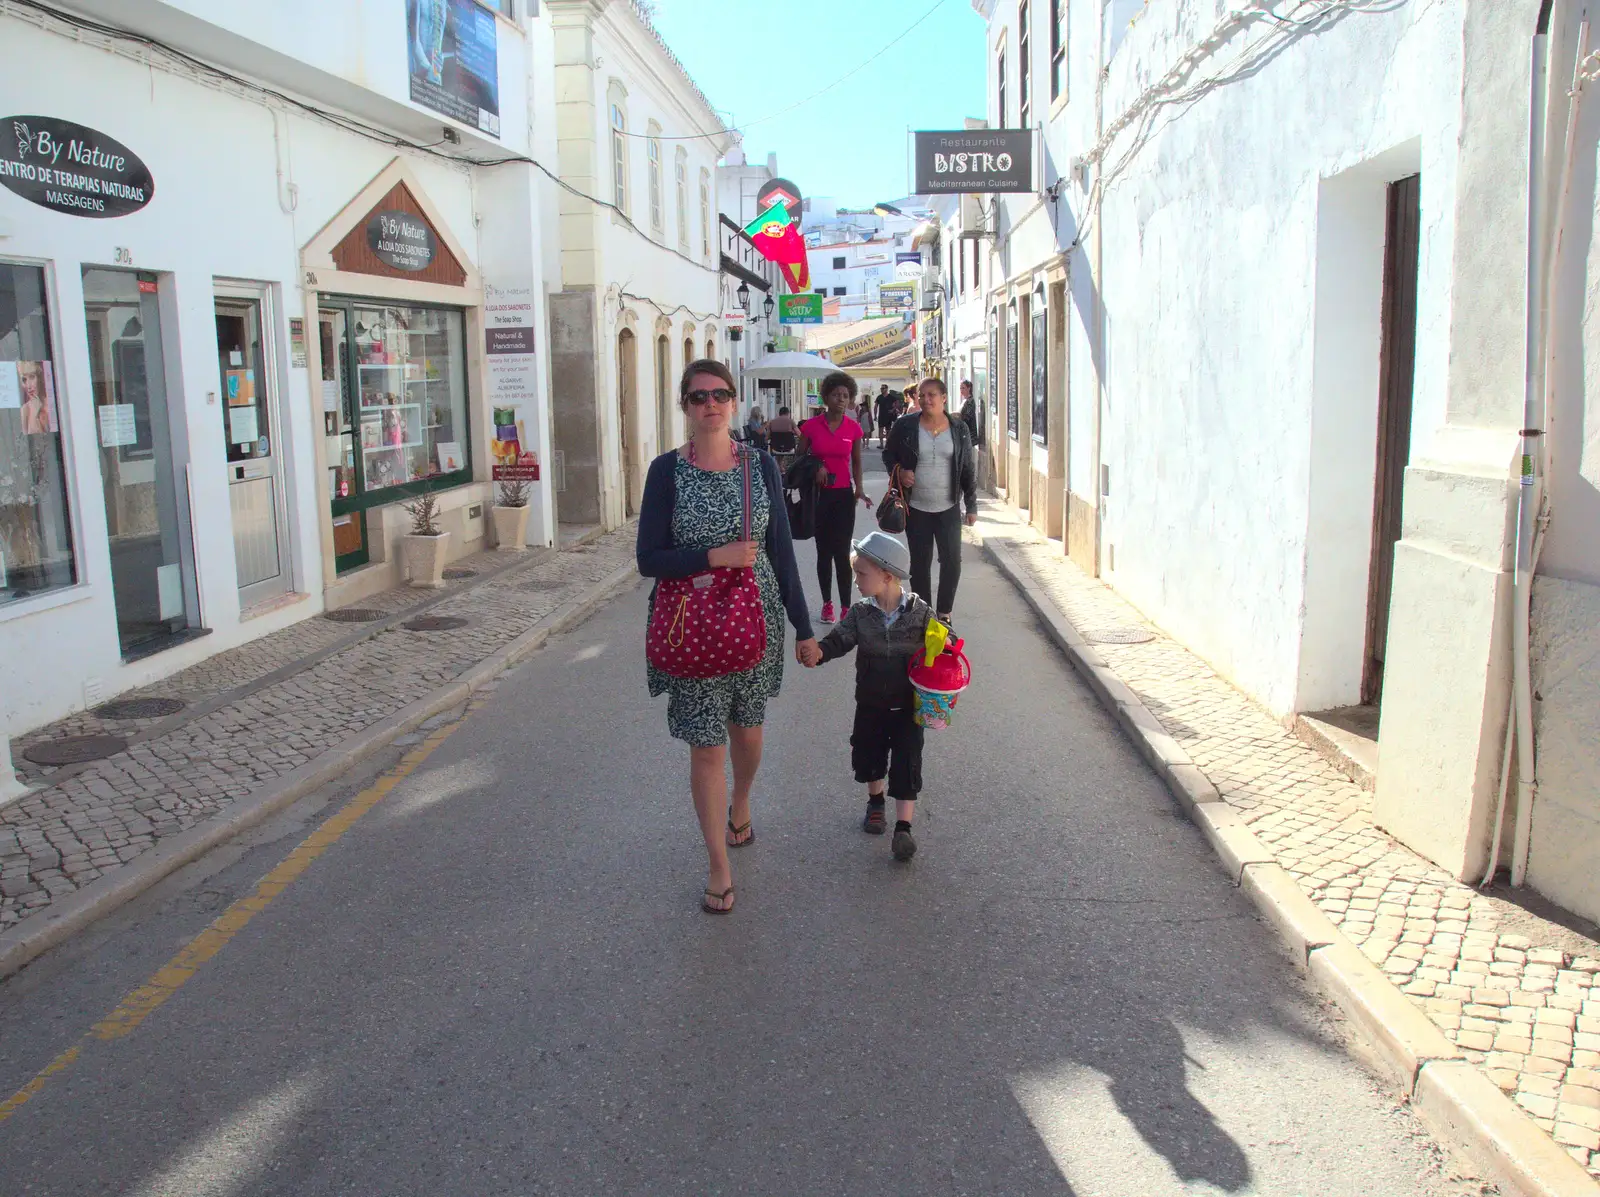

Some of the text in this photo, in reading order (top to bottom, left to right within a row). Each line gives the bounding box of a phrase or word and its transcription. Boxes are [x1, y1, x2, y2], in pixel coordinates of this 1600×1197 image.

[37, 131, 125, 172] By Nature
[940, 137, 1006, 147] Restaurante
[935, 152, 1012, 173] BISTRO
[0, 158, 144, 202] ENTRO DE TERAPIAS NATURAIS
[928, 179, 1018, 188] Mediterranean Cuisine
[46, 190, 105, 212] MASSAGENS
[389, 218, 426, 241] By Nature
[377, 240, 383, 250] A
[382, 240, 395, 252] LOJA
[395, 242, 405, 253] DOS
[494, 332, 517, 340] Natural
[844, 337, 874, 353] INDIAN
[884, 329, 898, 339] TAJ
